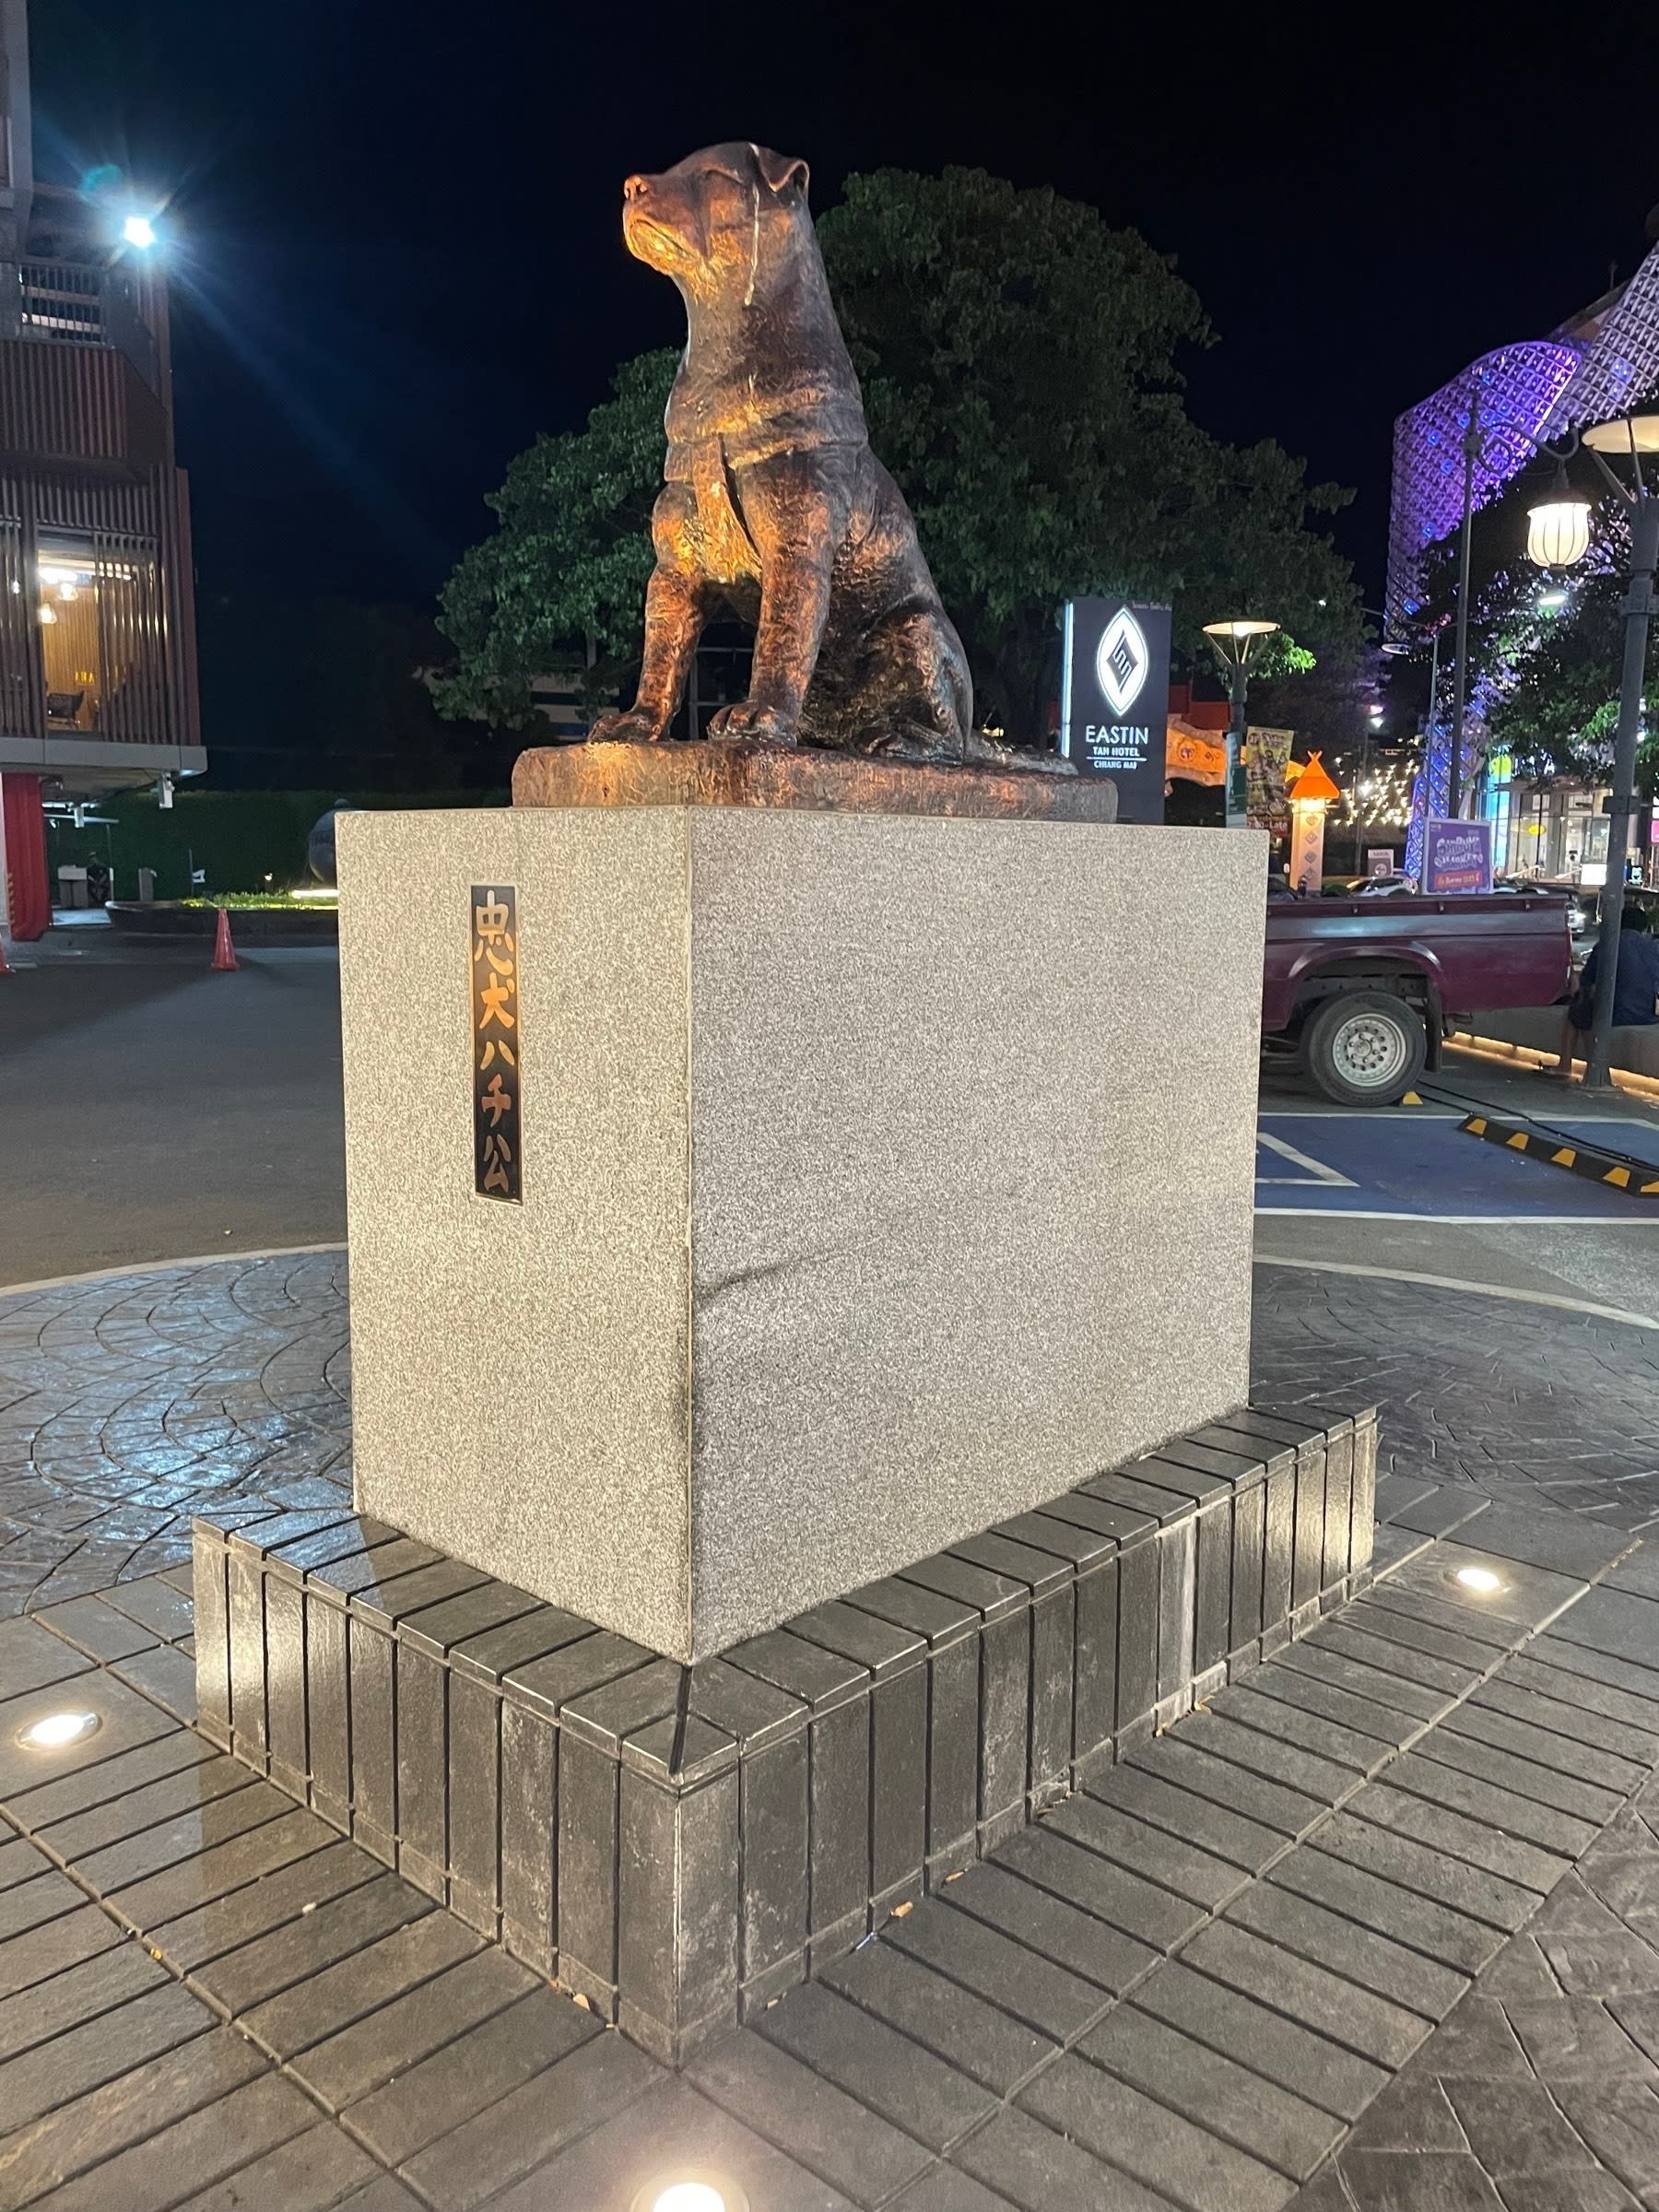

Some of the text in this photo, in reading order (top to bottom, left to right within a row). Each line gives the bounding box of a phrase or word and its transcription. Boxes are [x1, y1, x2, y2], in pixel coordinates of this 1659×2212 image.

[1086, 724, 1148, 745] EASTIN
[1093, 746, 1140, 757] TAN HOTEL
[1094, 759, 1122, 770] CHIANG
[474, 889, 515, 1194] 忠犬ハチ公
